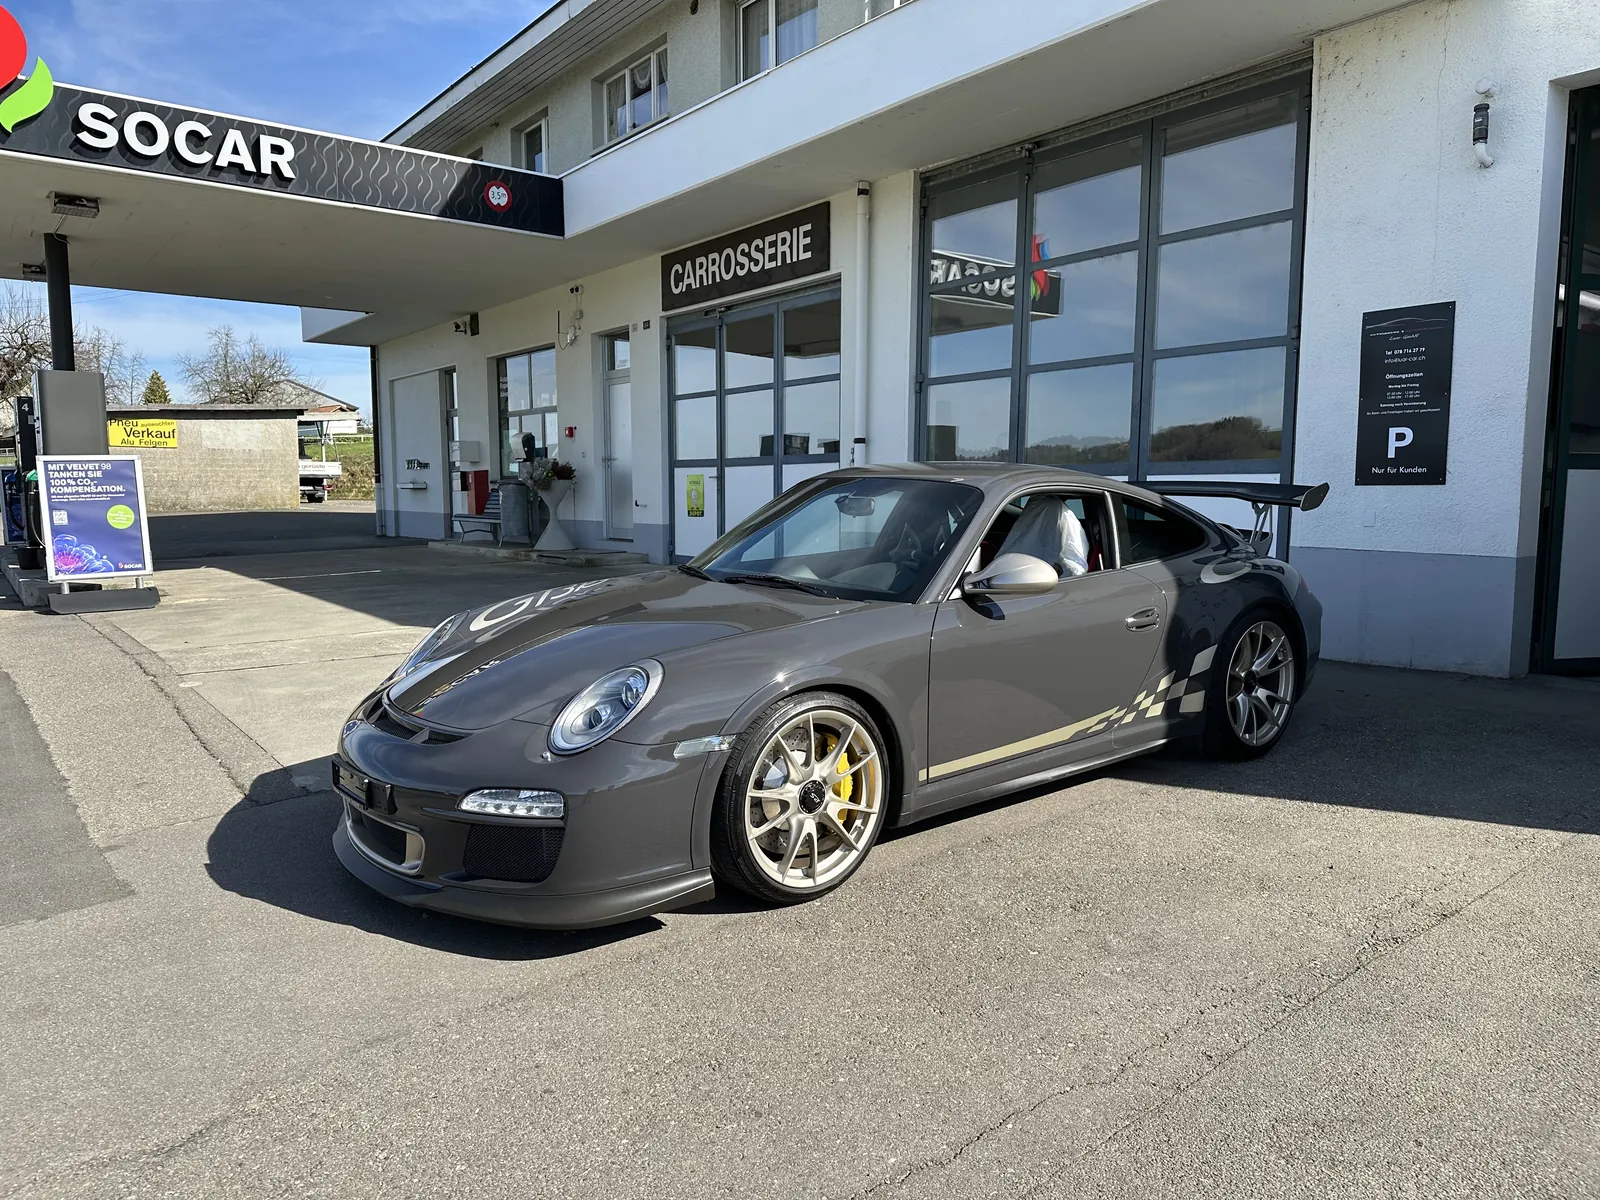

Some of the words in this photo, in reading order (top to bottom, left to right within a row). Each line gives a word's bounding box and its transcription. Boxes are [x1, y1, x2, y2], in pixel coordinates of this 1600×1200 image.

[76, 102, 296, 179] SOCAR
[670, 223, 812, 294] CARROSSERIE
[21, 403, 29, 412] 4
[109, 418, 138, 427] Pneu
[124, 427, 176, 439] Verkauf
[139, 439, 168, 447] Felgen
[1387, 426, 1414, 459] P
[50, 485, 126, 494] KOMPENSATION.
